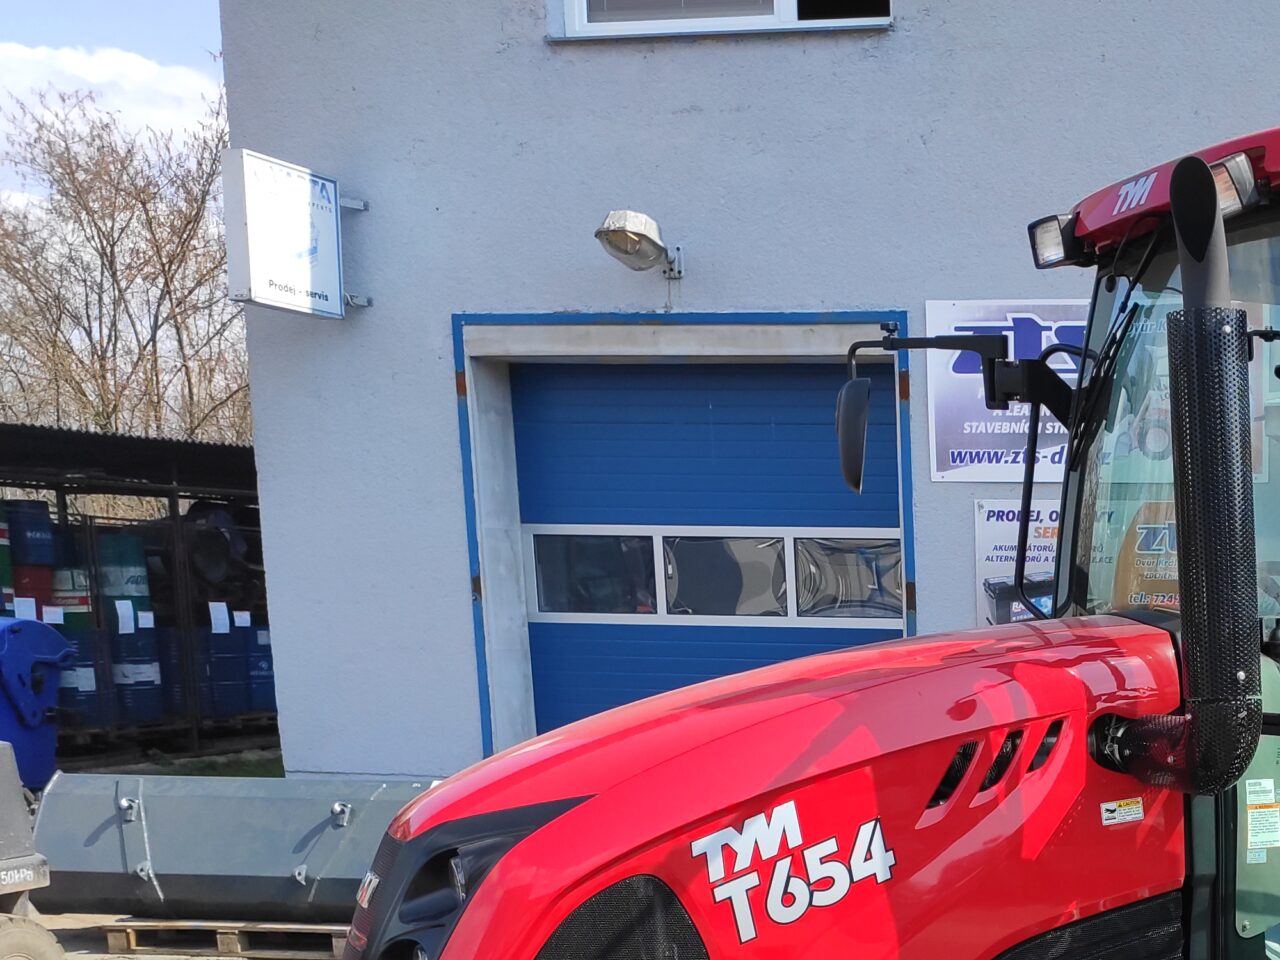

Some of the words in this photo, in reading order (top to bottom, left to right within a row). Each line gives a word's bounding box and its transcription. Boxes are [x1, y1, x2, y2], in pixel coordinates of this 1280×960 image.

[1112, 171, 1159, 216] TYM
[268, 279, 297, 297] Prodej
[305, 289, 330, 303] servis
[690, 799, 803, 884] TYM
